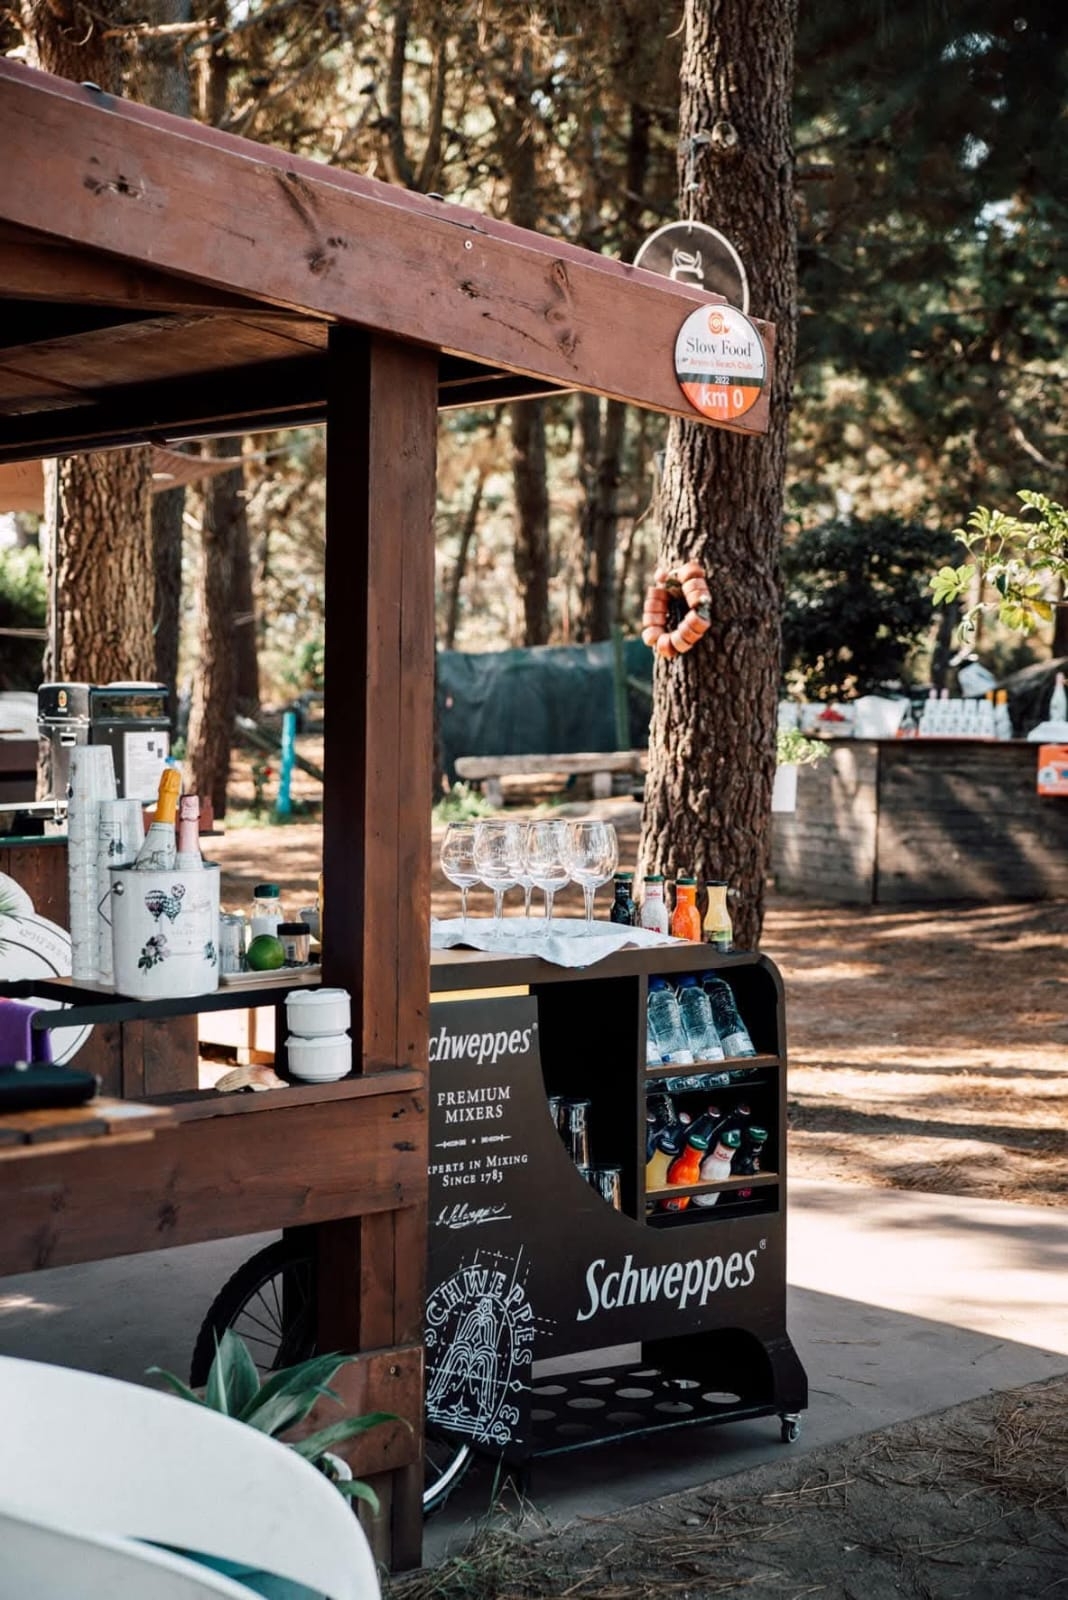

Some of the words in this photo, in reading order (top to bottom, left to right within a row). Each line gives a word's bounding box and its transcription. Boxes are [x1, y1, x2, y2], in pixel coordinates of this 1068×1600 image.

[687, 337, 717, 354] Slow
[722, 340, 752, 357] Food
[714, 376, 730, 385] 2022
[701, 387, 728, 408] km
[732, 388, 744, 409] 0
[428, 1027, 532, 1065] chweppes
[437, 1086, 511, 1106] PREMIUM
[445, 1104, 503, 1124] MIXERS
[480, 1168, 503, 1184] 1783
[576, 1250, 758, 1321] Schweppes
